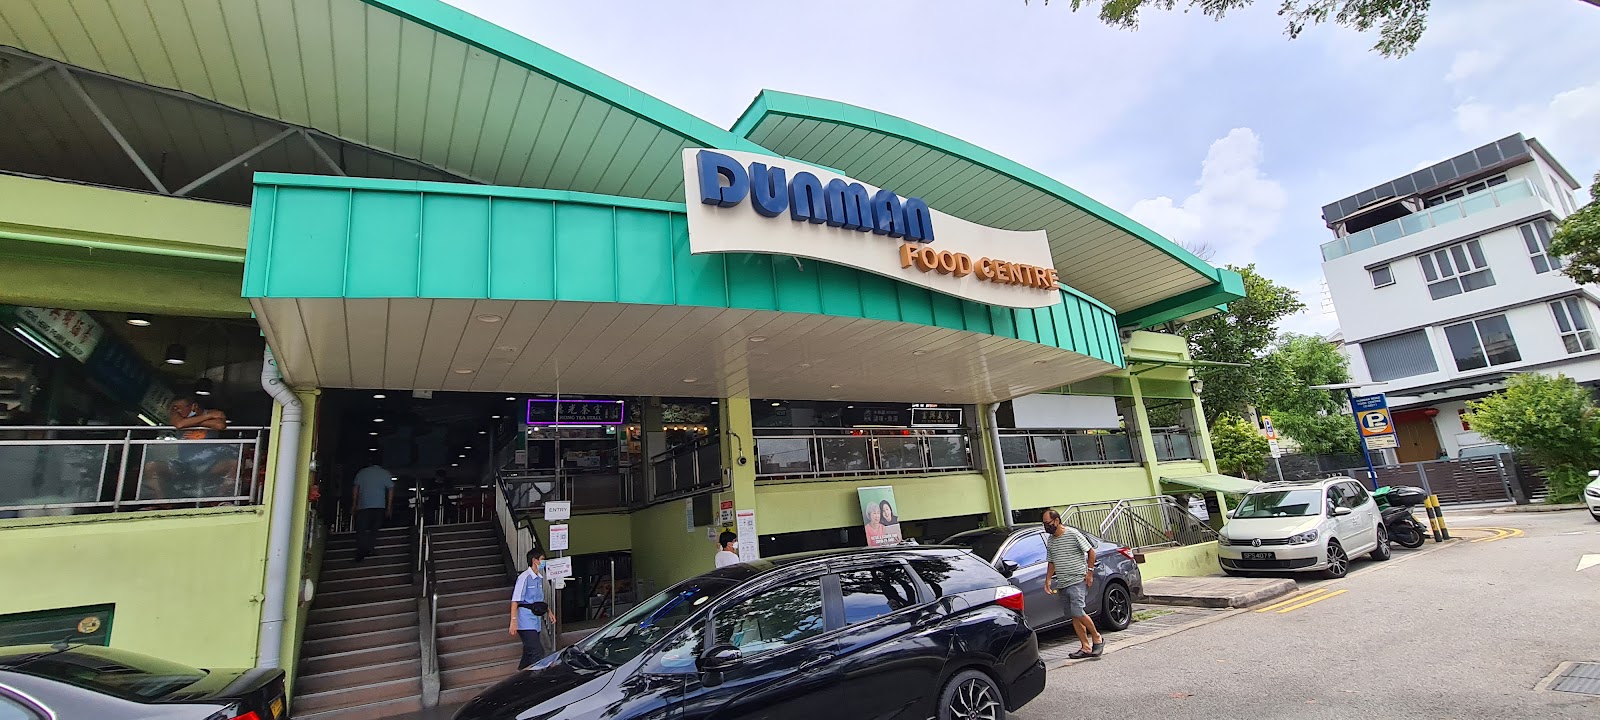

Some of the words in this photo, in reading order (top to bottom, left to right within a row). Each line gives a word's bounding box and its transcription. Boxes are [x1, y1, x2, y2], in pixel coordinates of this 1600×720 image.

[696, 149, 935, 243] DUNMAN
[900, 243, 973, 277] FOOD
[974, 257, 1060, 291] CENTRE
[1366, 413, 1385, 428] P
